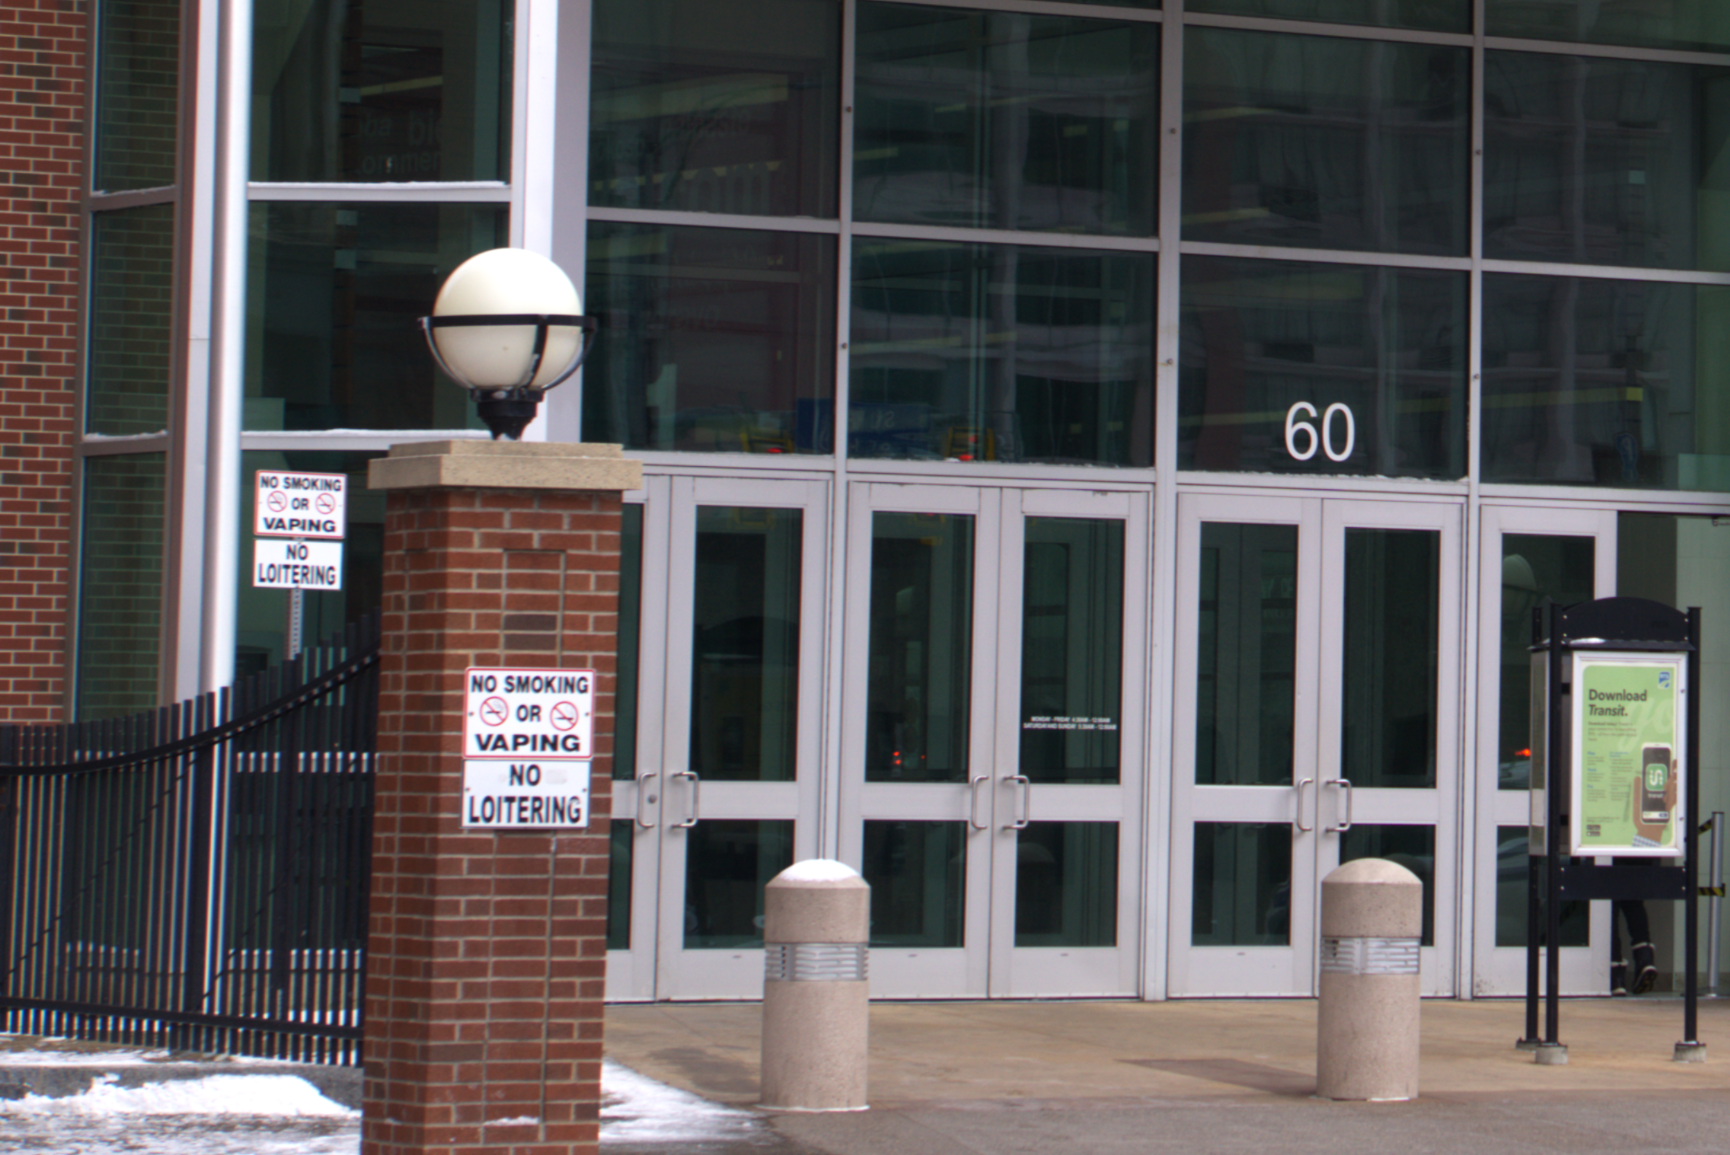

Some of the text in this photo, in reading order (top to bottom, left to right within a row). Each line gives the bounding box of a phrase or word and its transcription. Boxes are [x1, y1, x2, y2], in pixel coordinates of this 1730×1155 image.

[1285, 400, 1355, 462] 60
[260, 475, 342, 492] NO SMOKING
[291, 497, 310, 511] OR
[262, 516, 336, 533] VAPING
[286, 544, 309, 561] NO
[258, 562, 336, 586] LOITERING
[471, 675, 590, 694] NO SMOKING
[1588, 688, 1648, 702] Download
[516, 704, 542, 722] OR
[1588, 704, 1629, 717] Transit.
[474, 733, 582, 752] VAPING
[508, 763, 542, 787] NO
[468, 795, 582, 825] LOITERING
